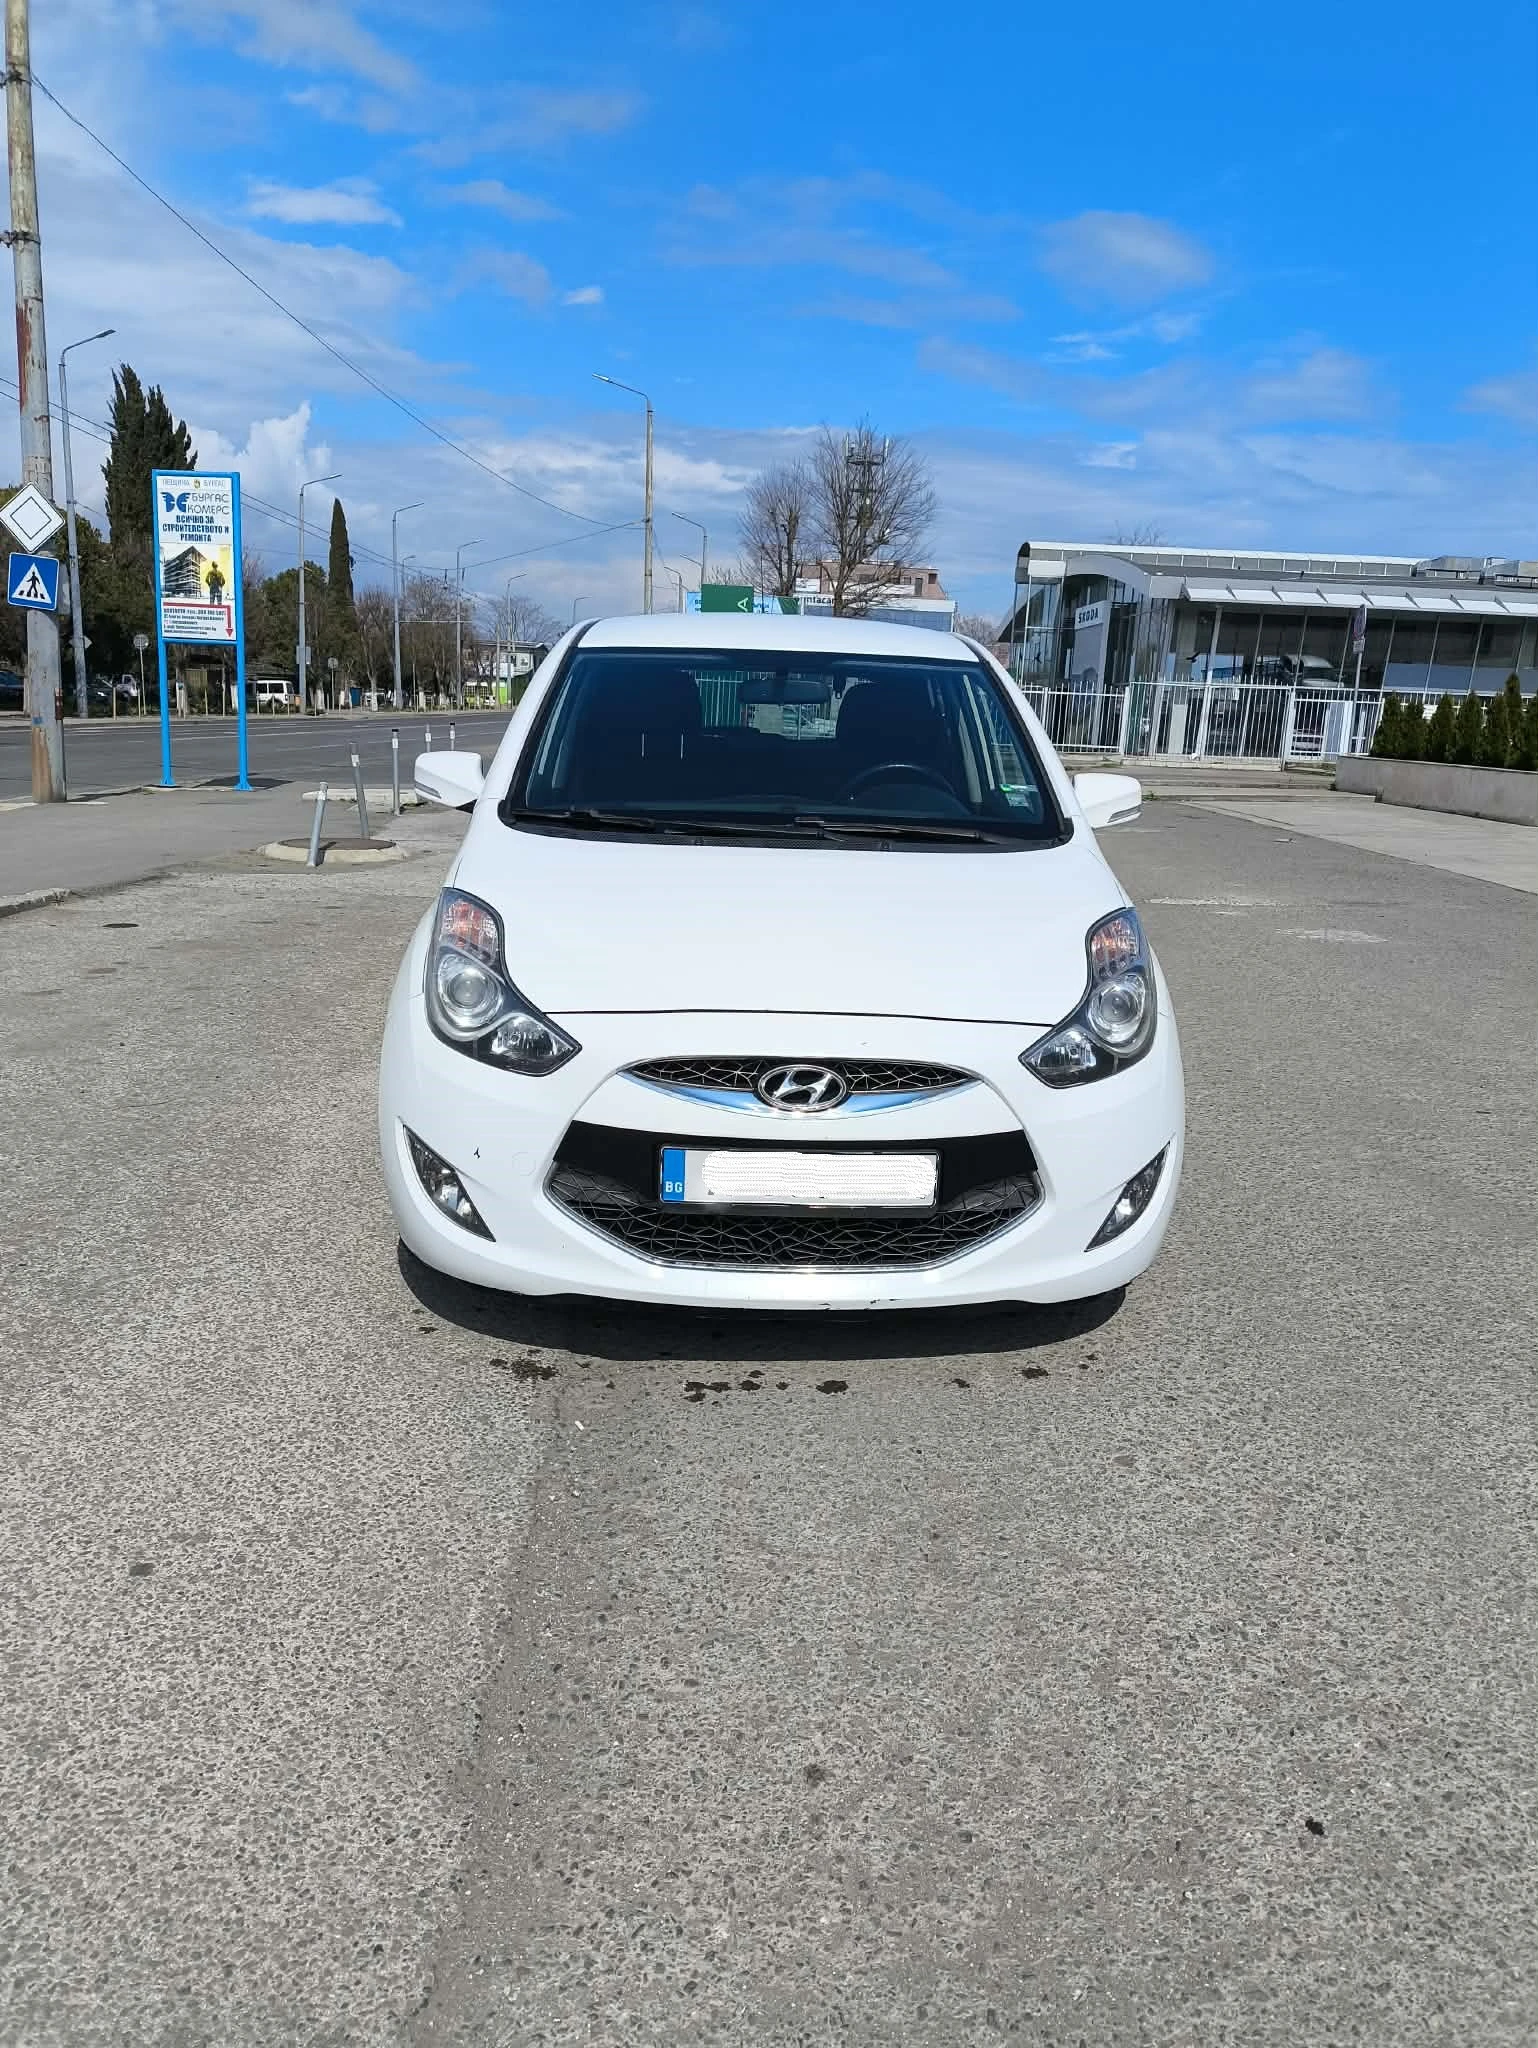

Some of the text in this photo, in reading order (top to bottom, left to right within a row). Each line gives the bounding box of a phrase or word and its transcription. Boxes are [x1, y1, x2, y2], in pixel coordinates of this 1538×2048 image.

[191, 493, 230, 503] БУРГАС
[187, 504, 230, 515] КОМЕРС
[205, 516, 215, 524] ЗА
[180, 533, 212, 542] РЕМОНТА
[665, 1180, 683, 1193] BG
